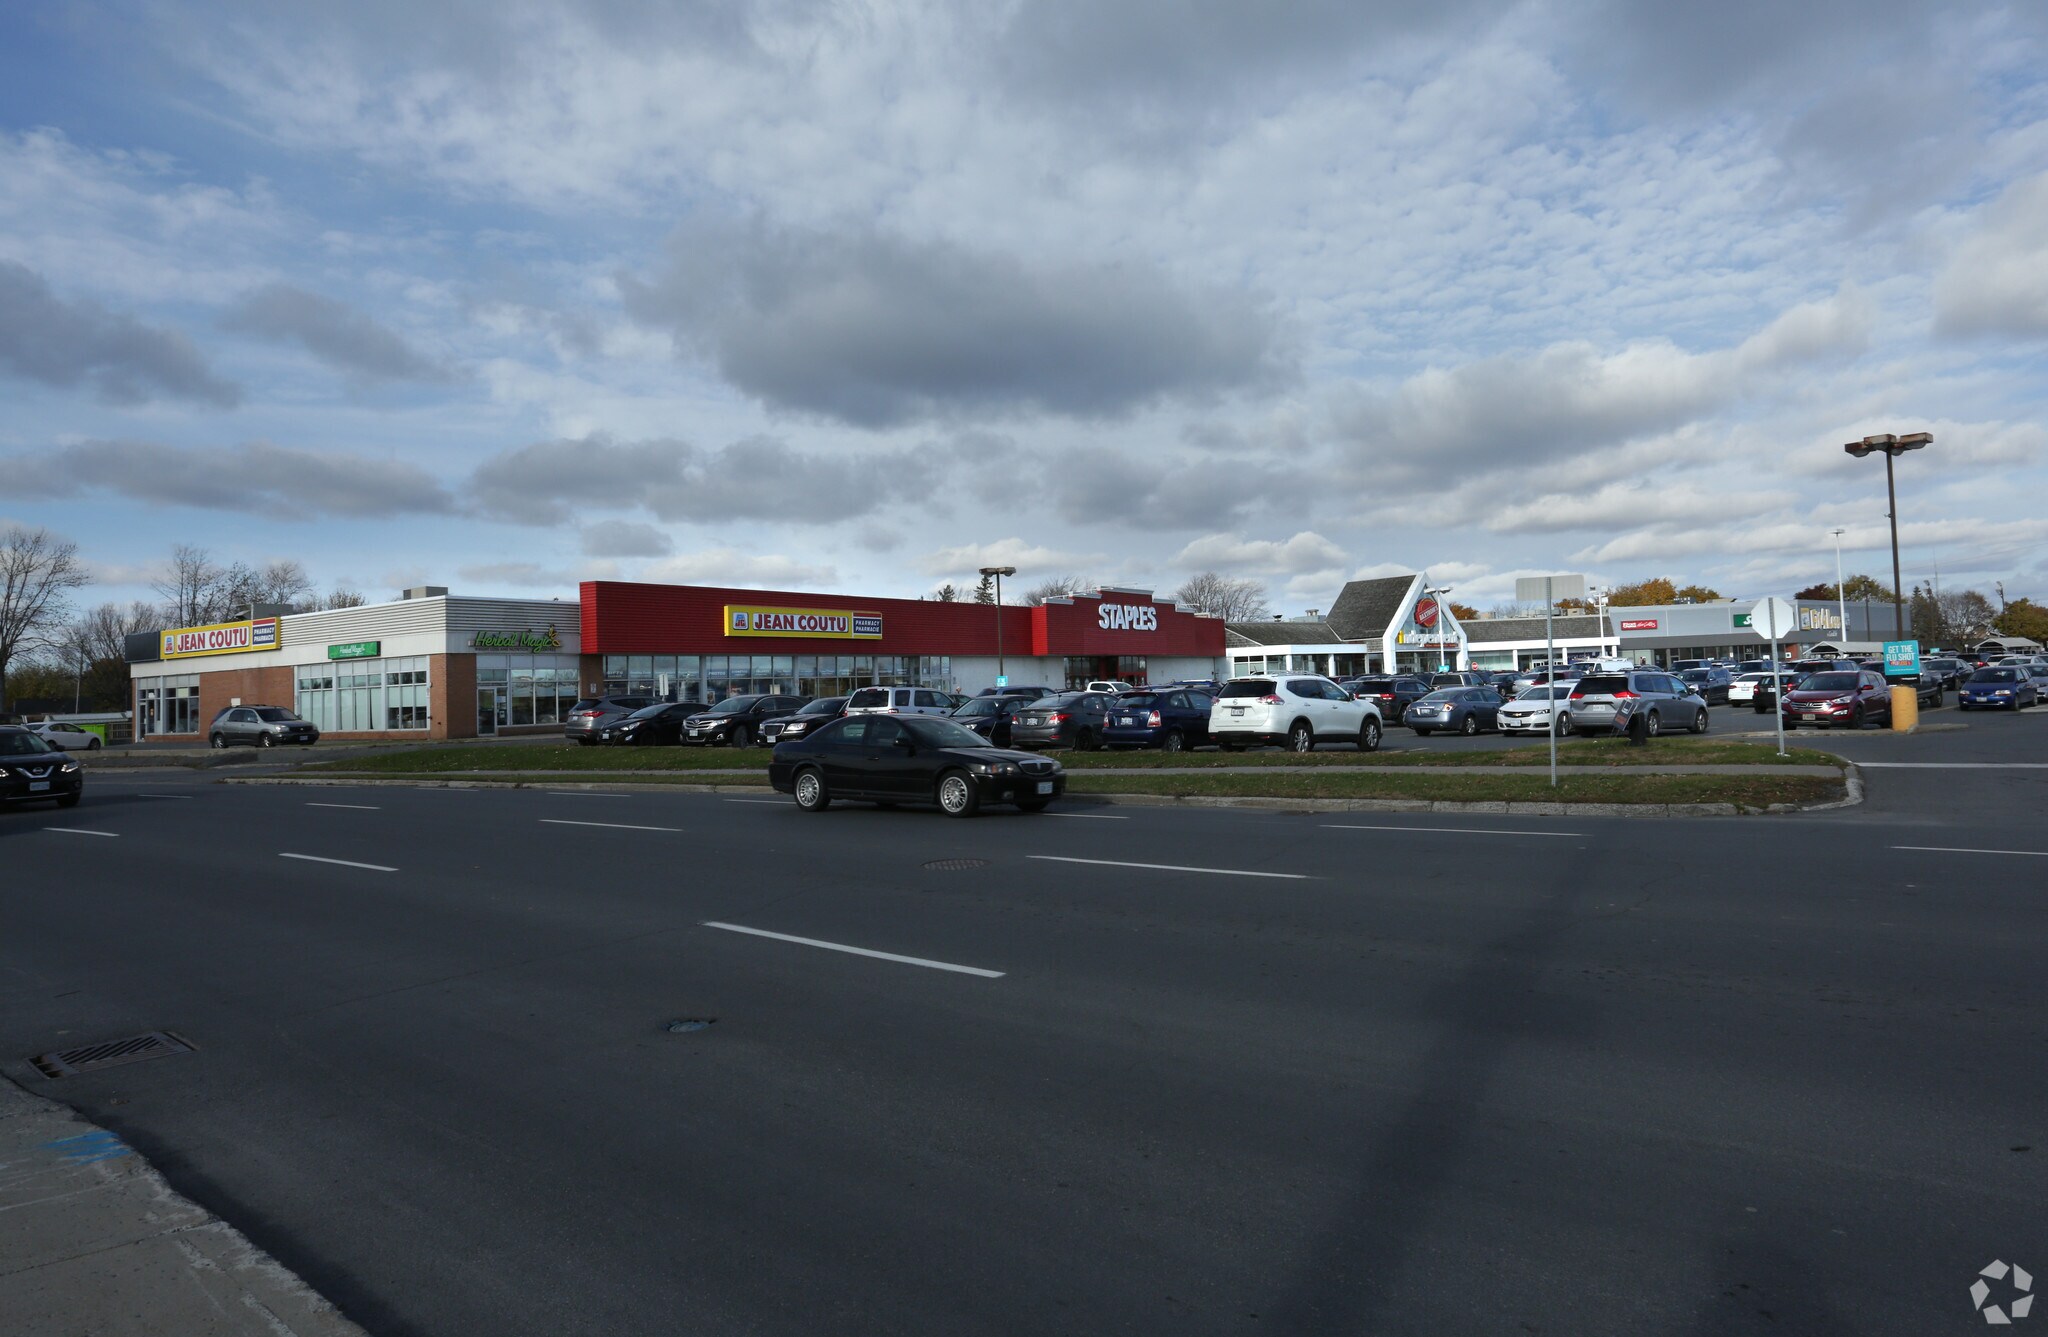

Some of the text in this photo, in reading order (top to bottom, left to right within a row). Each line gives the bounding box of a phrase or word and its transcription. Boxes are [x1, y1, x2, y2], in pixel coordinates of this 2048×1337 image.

[754, 613, 847, 632] JEAN COUTU
[1098, 603, 1158, 631] STAPLES
[177, 627, 248, 652] JEAN COUTU
[475, 631, 553, 654] Herbal Magic
[1887, 644, 1913, 654] GET THE
[1886, 652, 1915, 662] FLU SHOT
